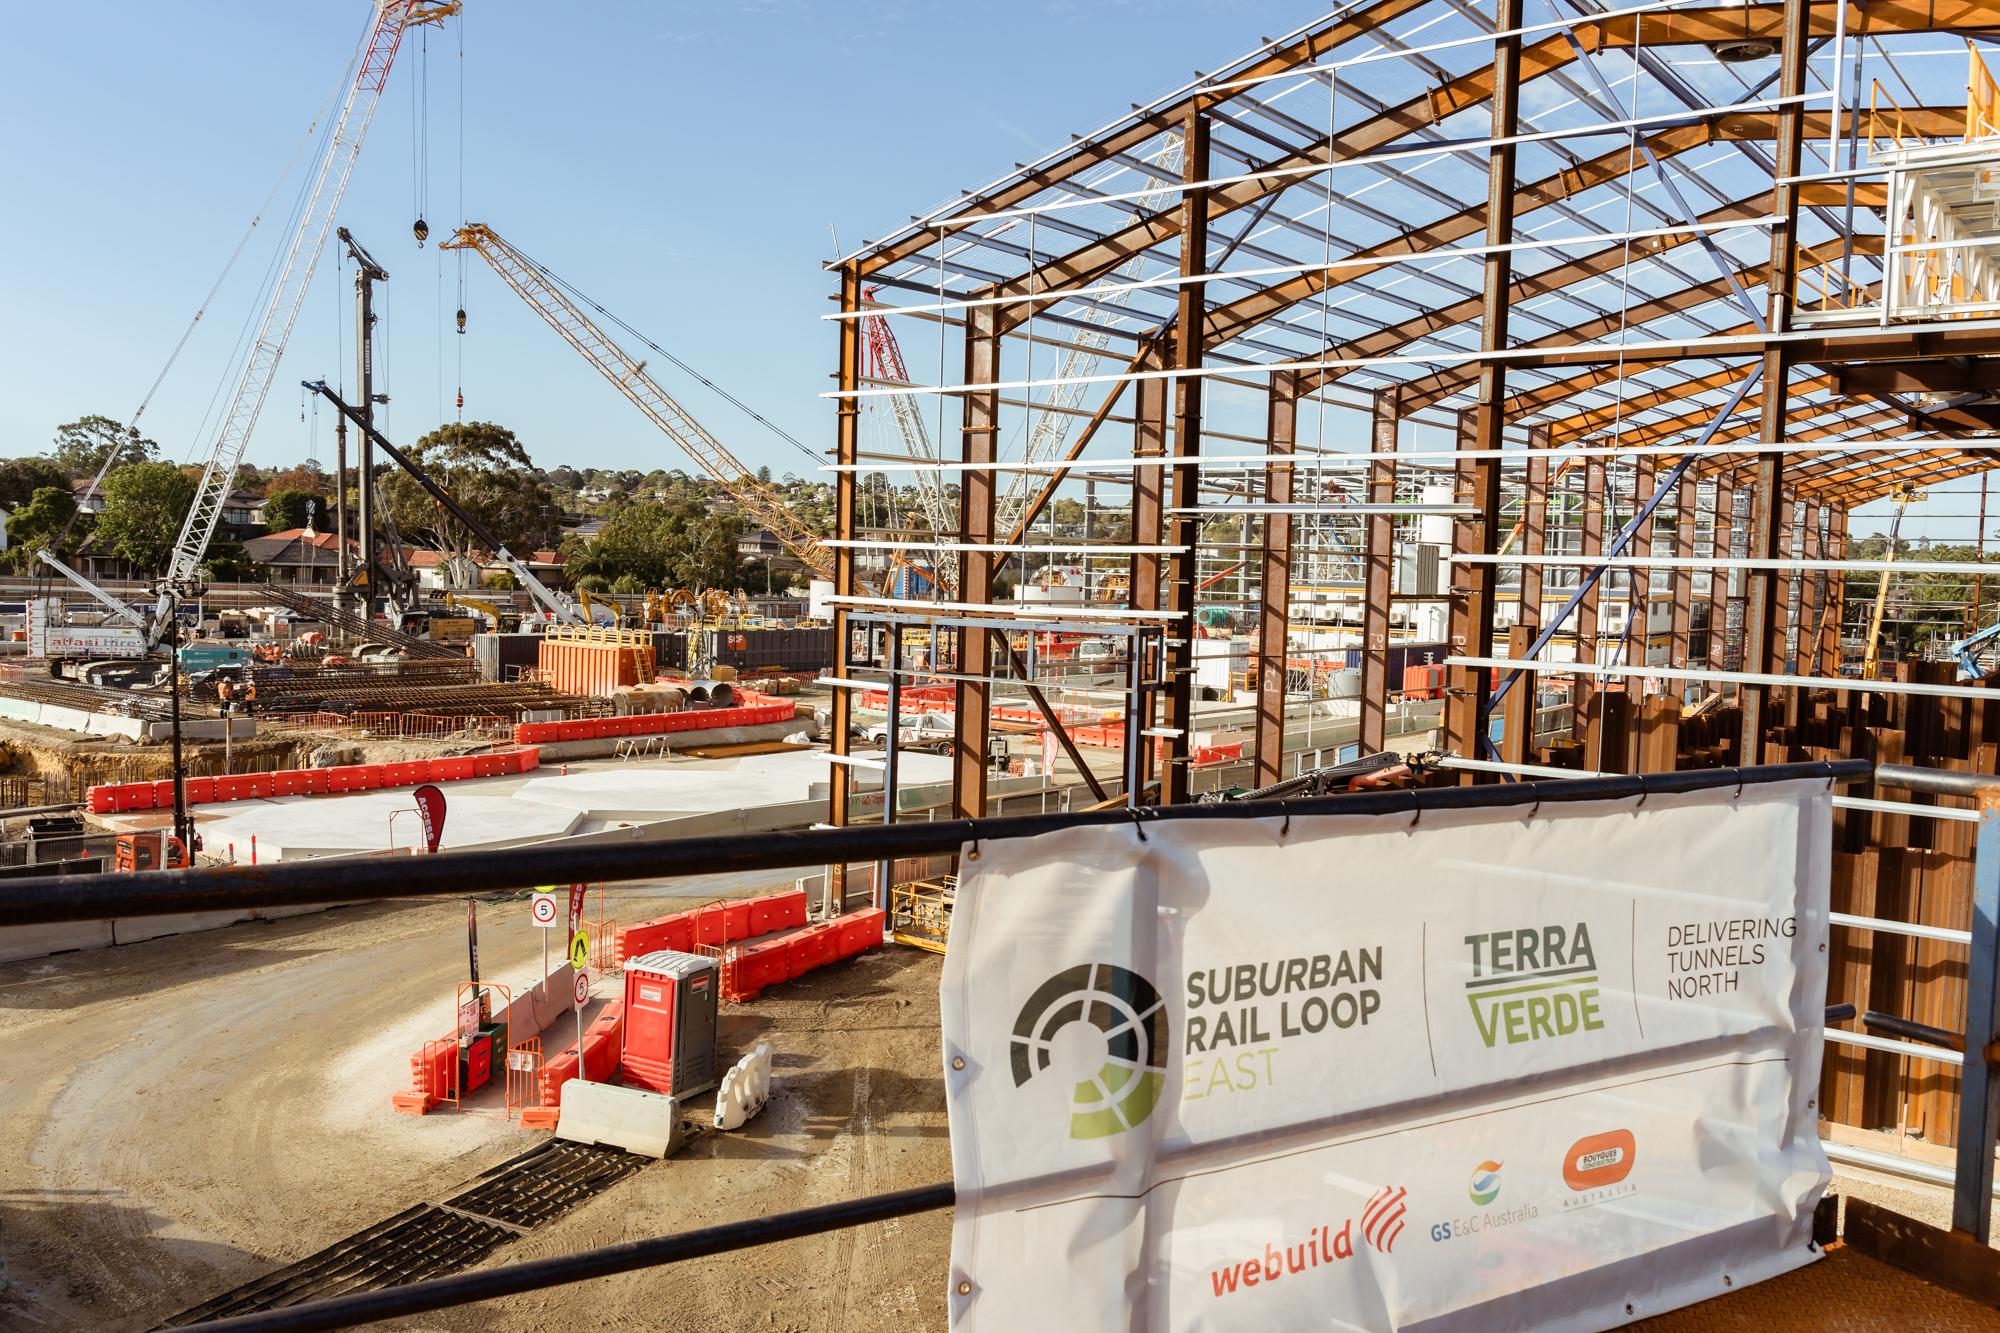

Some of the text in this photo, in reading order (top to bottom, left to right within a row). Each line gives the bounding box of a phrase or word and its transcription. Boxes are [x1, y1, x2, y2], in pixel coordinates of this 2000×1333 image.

[52, 636, 136, 647] alfasi hire
[727, 635, 743, 643] SCF
[418, 797, 434, 841] ACCESS
[540, 904, 548, 916] 5
[1668, 917, 1797, 947] DELIVERING
[1464, 921, 1597, 978] TERRA
[1667, 944, 1765, 974] TUNNELS
[579, 981, 584, 996] 5
[1186, 946, 1383, 1009] SUBURBAN
[1668, 971, 1739, 1000] NORTH
[1185, 989, 1381, 1056] RAIL LOOP
[1467, 988, 1605, 1049] VERDE
[1183, 1047, 1279, 1101] EAST
[1583, 1149, 1617, 1163] BOUYGUES
[1563, 1183, 1637, 1208] AUSTRALIA
[1431, 1204, 1538, 1242] GS E&C Australia
[1211, 1218, 1354, 1298] webuild
